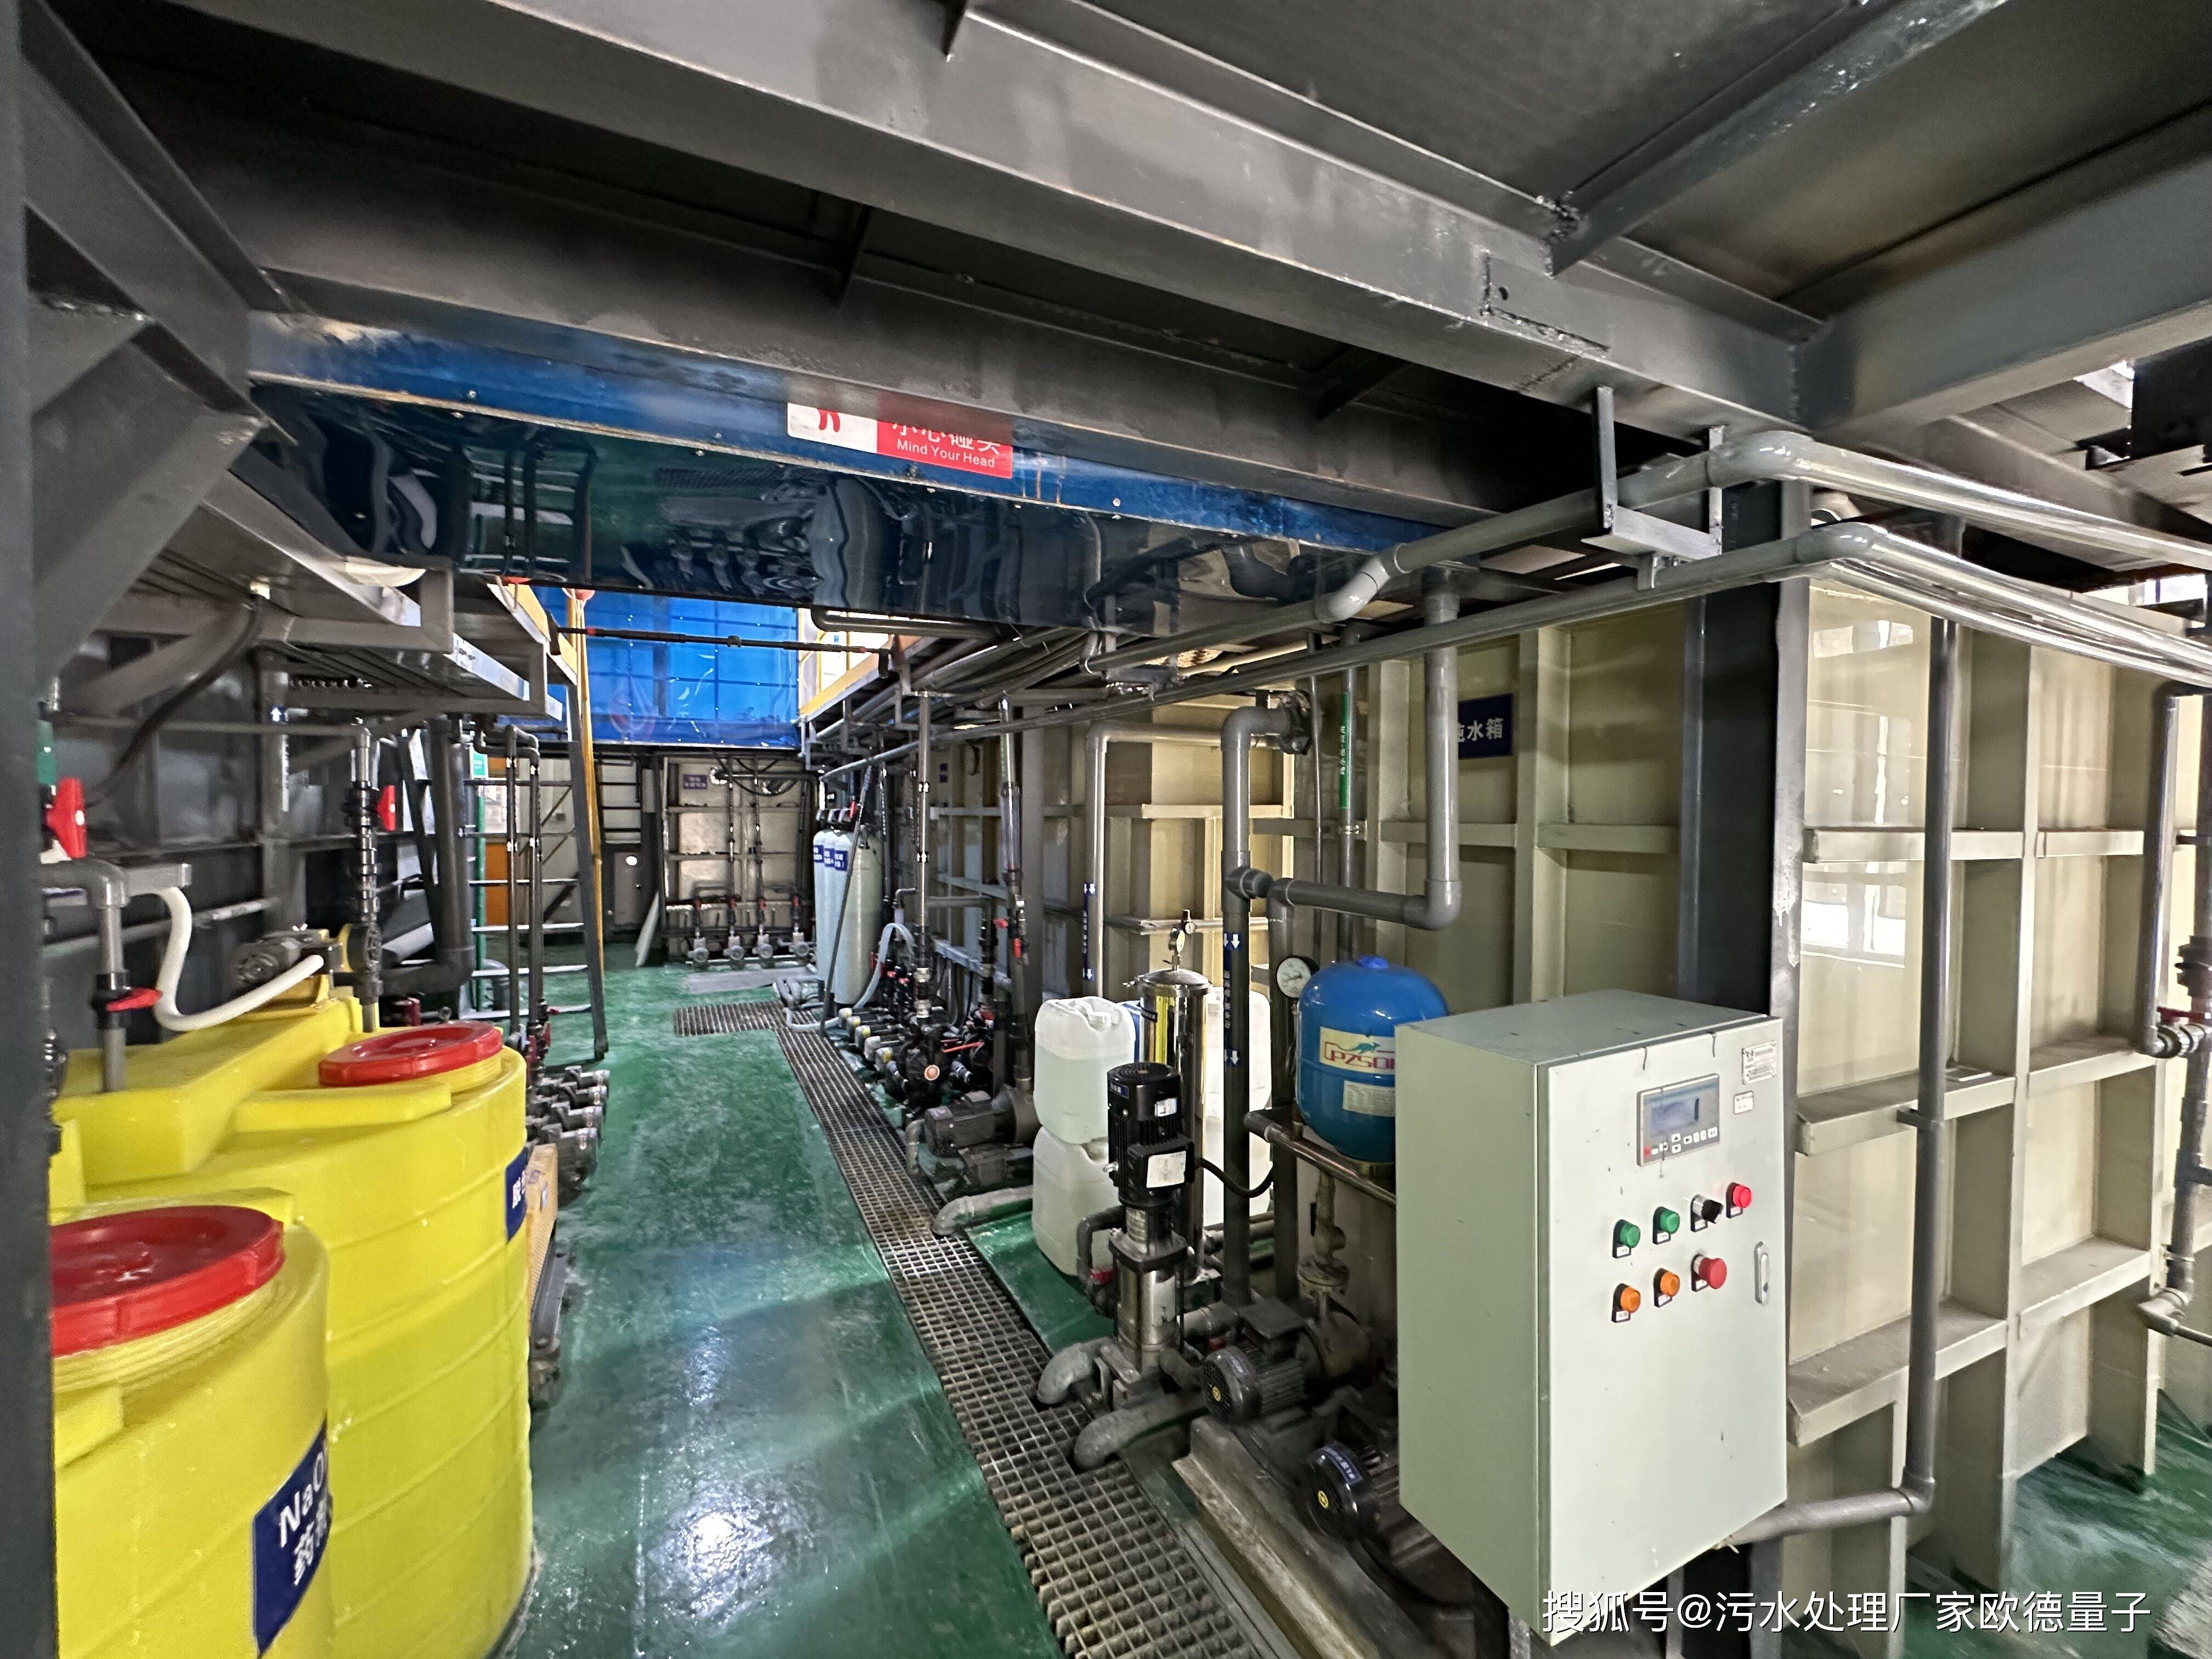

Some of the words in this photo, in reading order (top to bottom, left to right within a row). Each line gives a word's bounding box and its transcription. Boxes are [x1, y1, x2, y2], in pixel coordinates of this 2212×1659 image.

[897, 438, 928, 455] Mind
[932, 445, 960, 461] Your
[963, 452, 995, 468] Head
